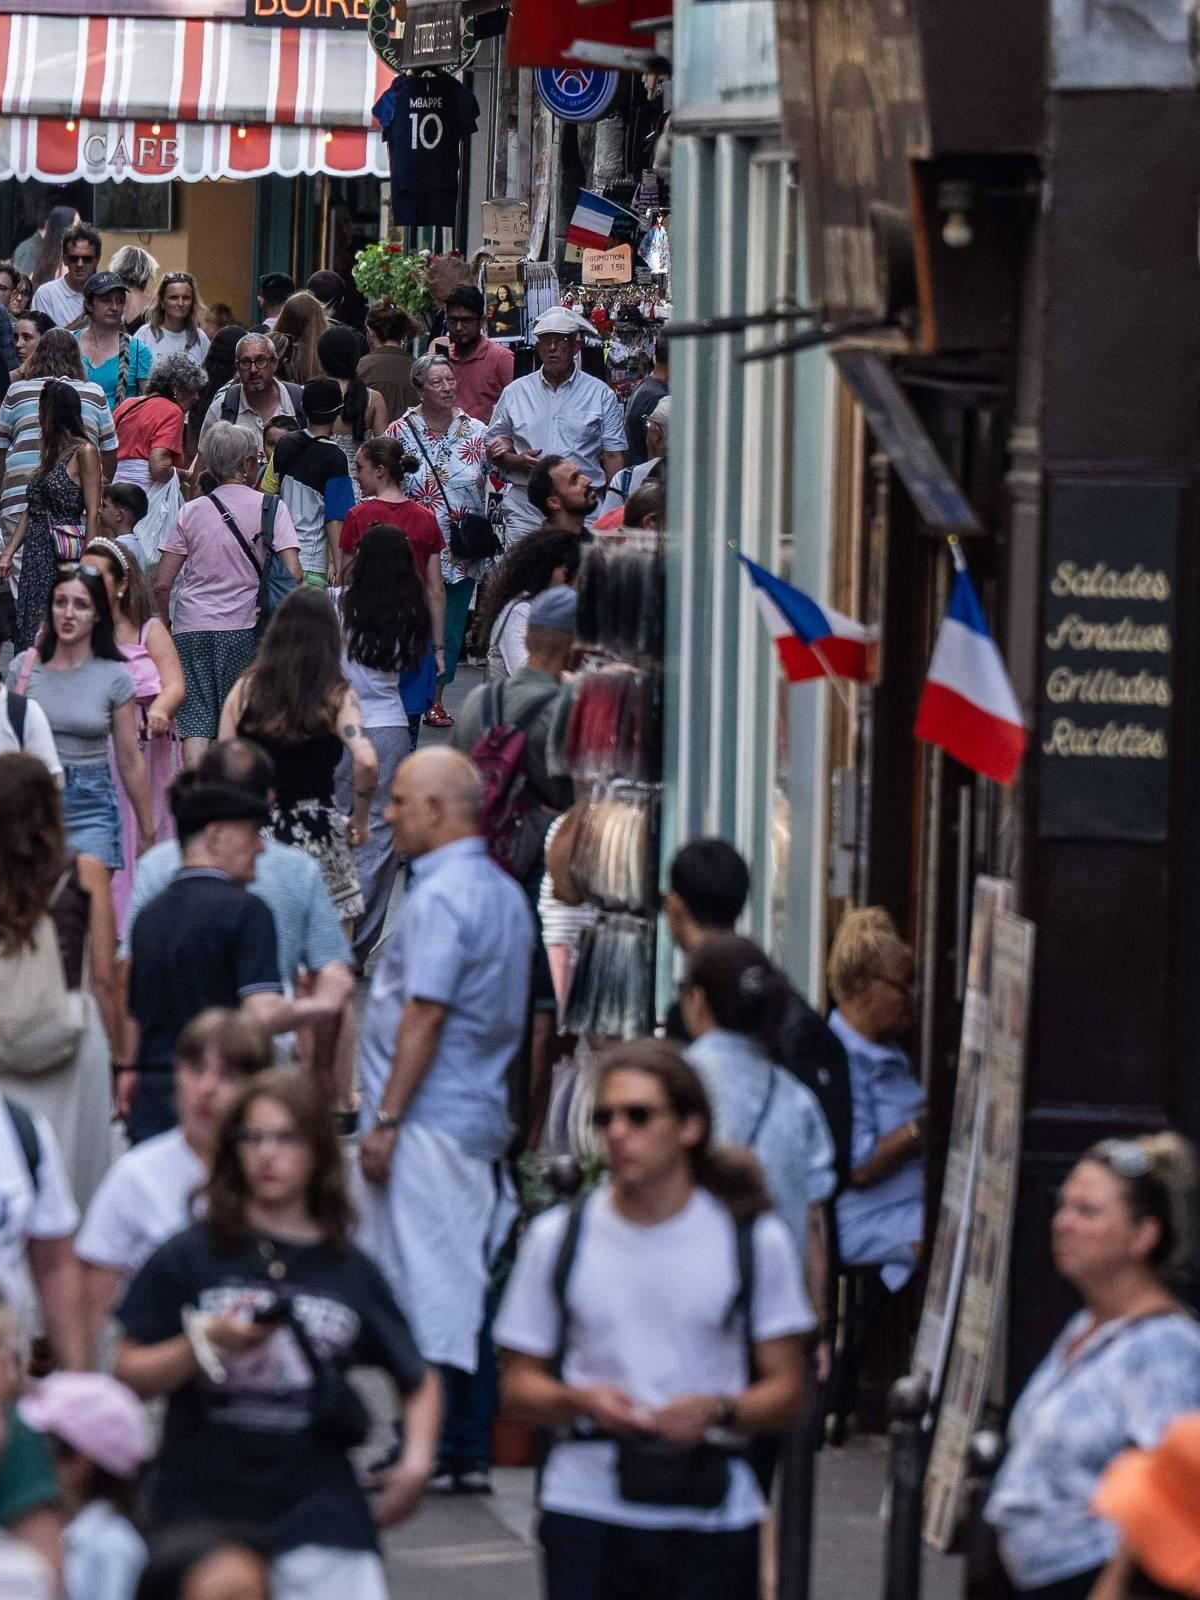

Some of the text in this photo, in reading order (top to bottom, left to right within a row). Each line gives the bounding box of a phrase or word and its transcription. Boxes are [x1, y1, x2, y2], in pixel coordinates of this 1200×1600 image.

[83, 134, 179, 168] CAFE
[408, 113, 443, 150] 10
[584, 253, 625, 264] PROMOTION
[1051, 560, 1170, 601] Salades
[1046, 666, 1173, 707] Grillades
[1042, 717, 1170, 760] Raclettes
